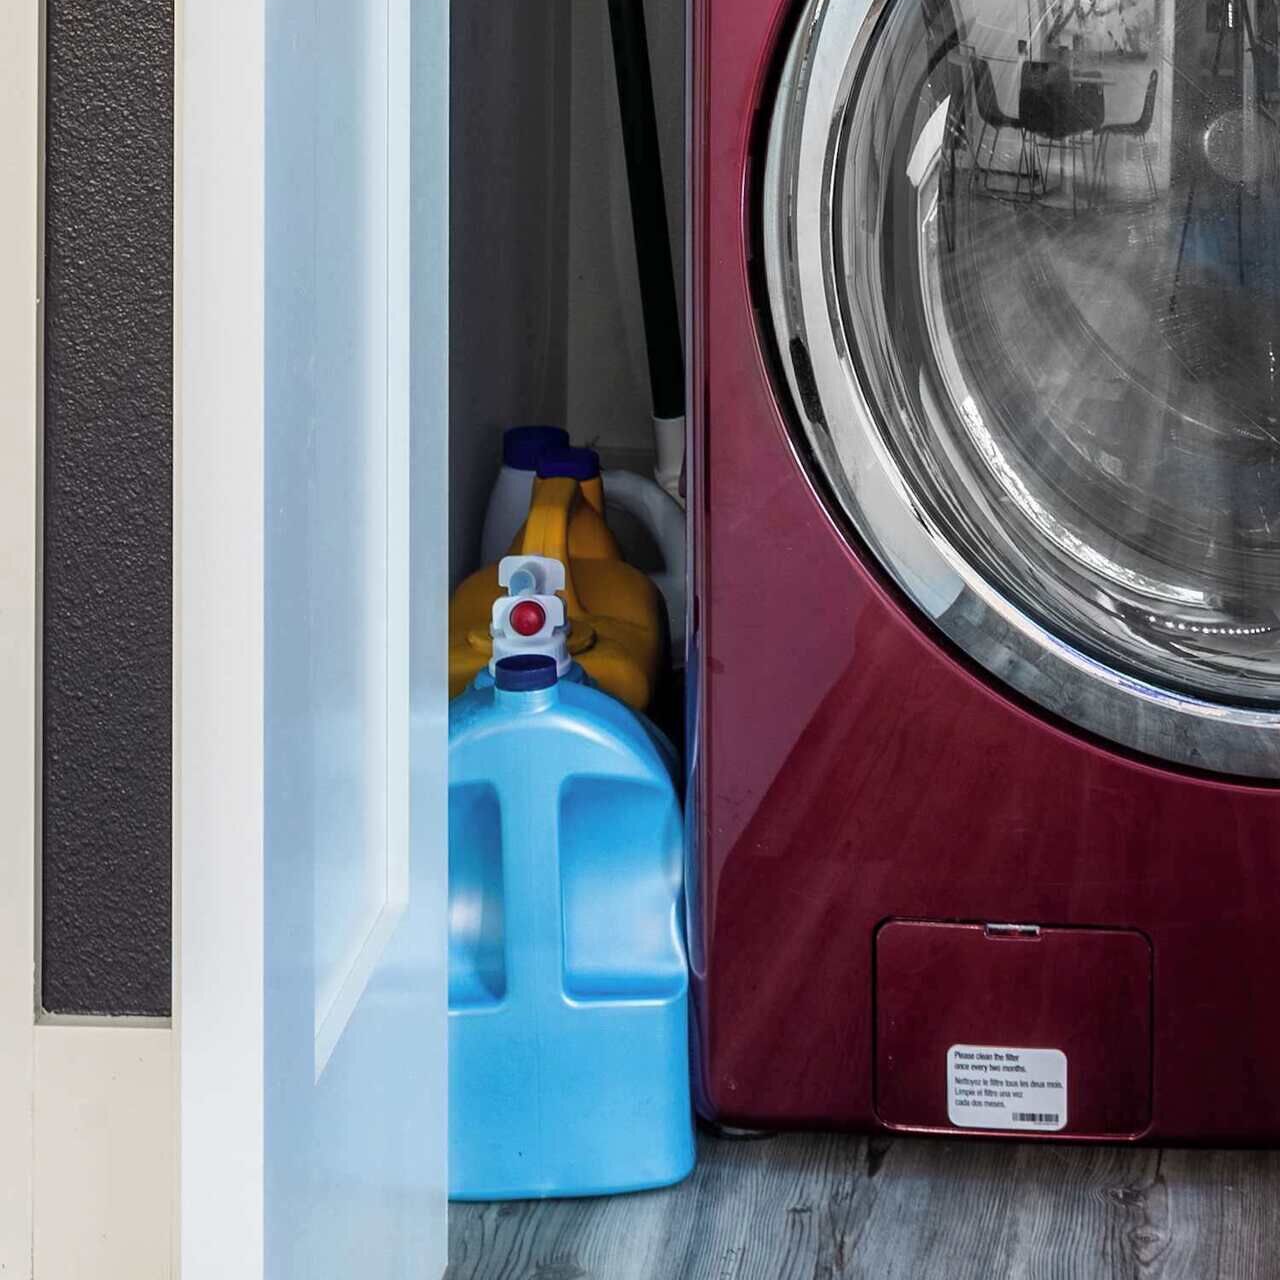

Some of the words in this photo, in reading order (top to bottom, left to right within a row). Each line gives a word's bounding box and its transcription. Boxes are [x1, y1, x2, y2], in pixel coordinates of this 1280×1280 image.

[976, 1052, 992, 1060] clean
[995, 1053, 1004, 1061] the
[971, 1064, 987, 1072] every
